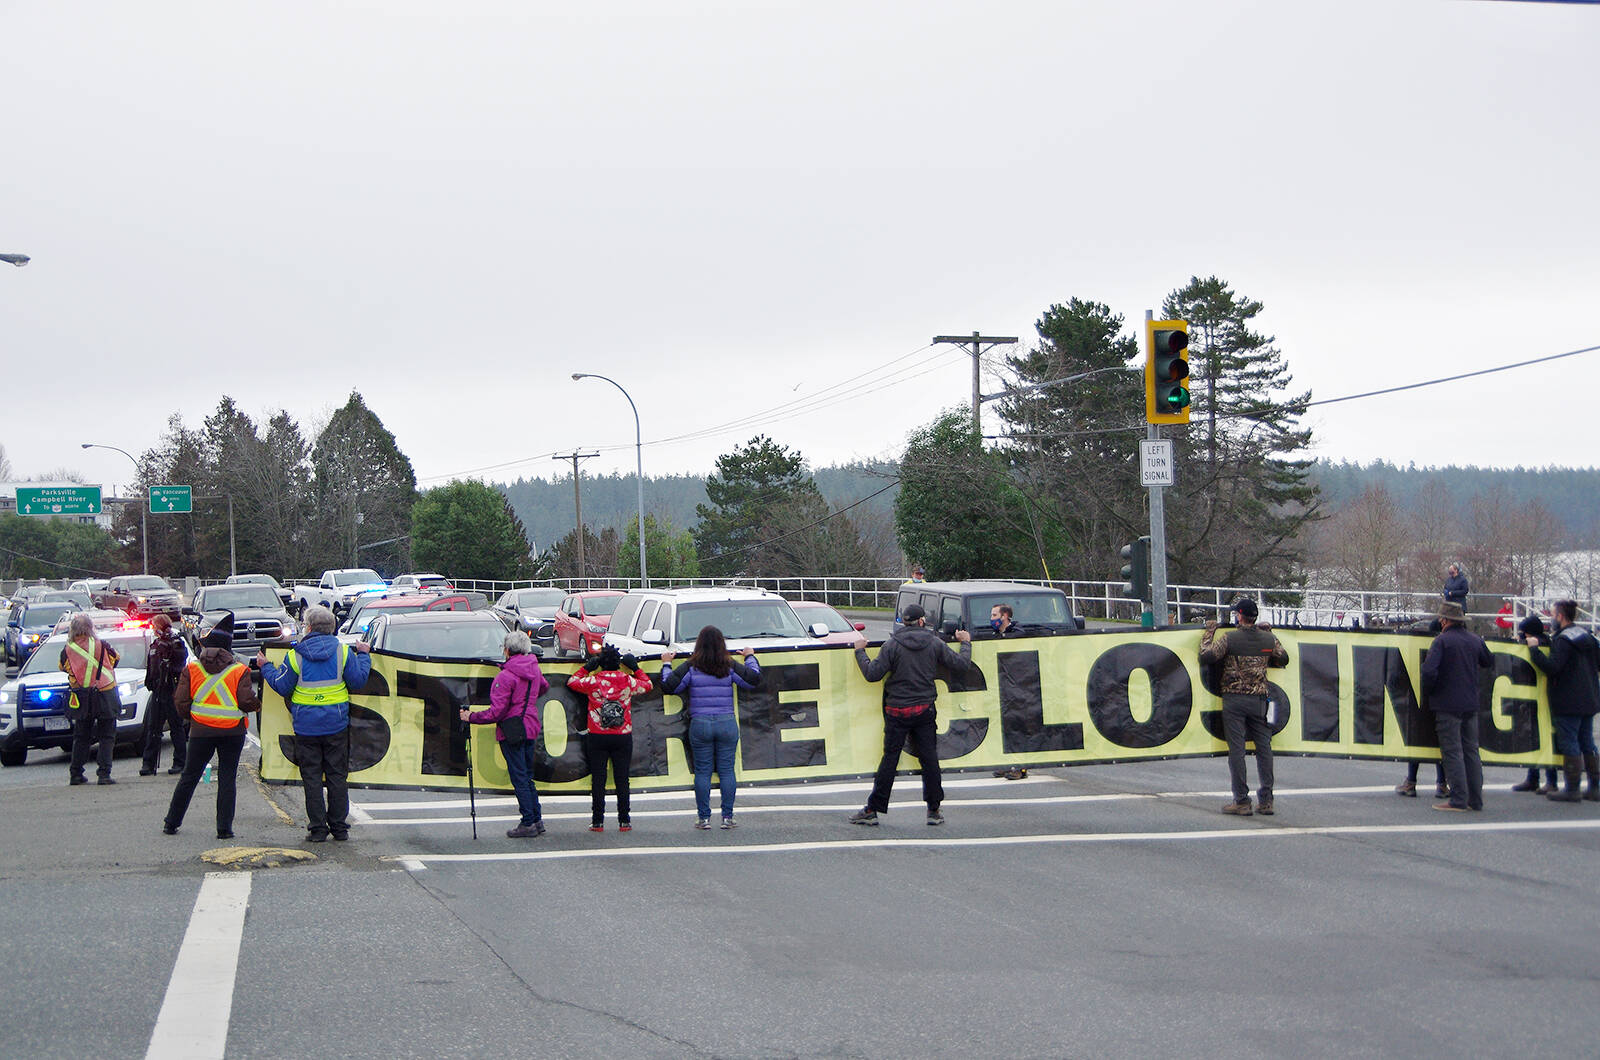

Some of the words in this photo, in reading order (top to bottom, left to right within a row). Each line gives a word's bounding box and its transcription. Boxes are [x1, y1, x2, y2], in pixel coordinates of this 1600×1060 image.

[1147, 445, 1165, 455] LEFT
[1147, 458, 1166, 467] TURN
[1144, 471, 1169, 480] SIGNAL
